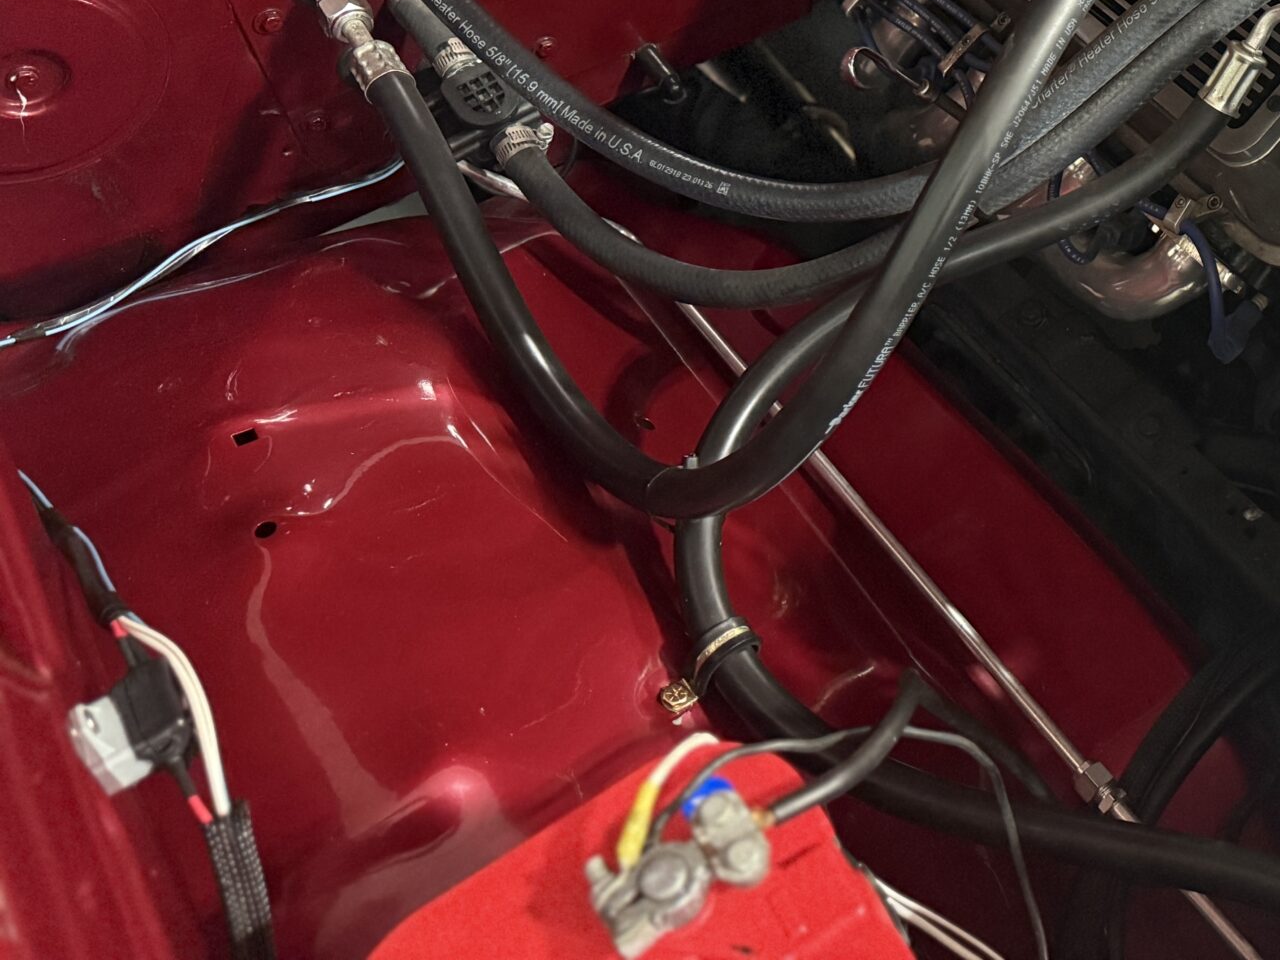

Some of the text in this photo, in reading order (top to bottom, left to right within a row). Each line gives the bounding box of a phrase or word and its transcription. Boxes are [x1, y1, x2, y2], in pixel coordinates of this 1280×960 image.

[458, 19, 487, 50] Hose
[485, 46, 513, 67] 5/8"
[560, 104, 594, 134] Made
[593, 126, 607, 143] in
[1078, 32, 1115, 68] Heater
[1117, 3, 1148, 34] Hose
[928, 256, 945, 278] HOSE
[943, 235, 957, 251] 1/2
[1000, 130, 1014, 149] SAE
[1040, 51, 1057, 76] MADE
[1055, 37, 1066, 50] IN
[1064, 17, 1078, 36] USA
